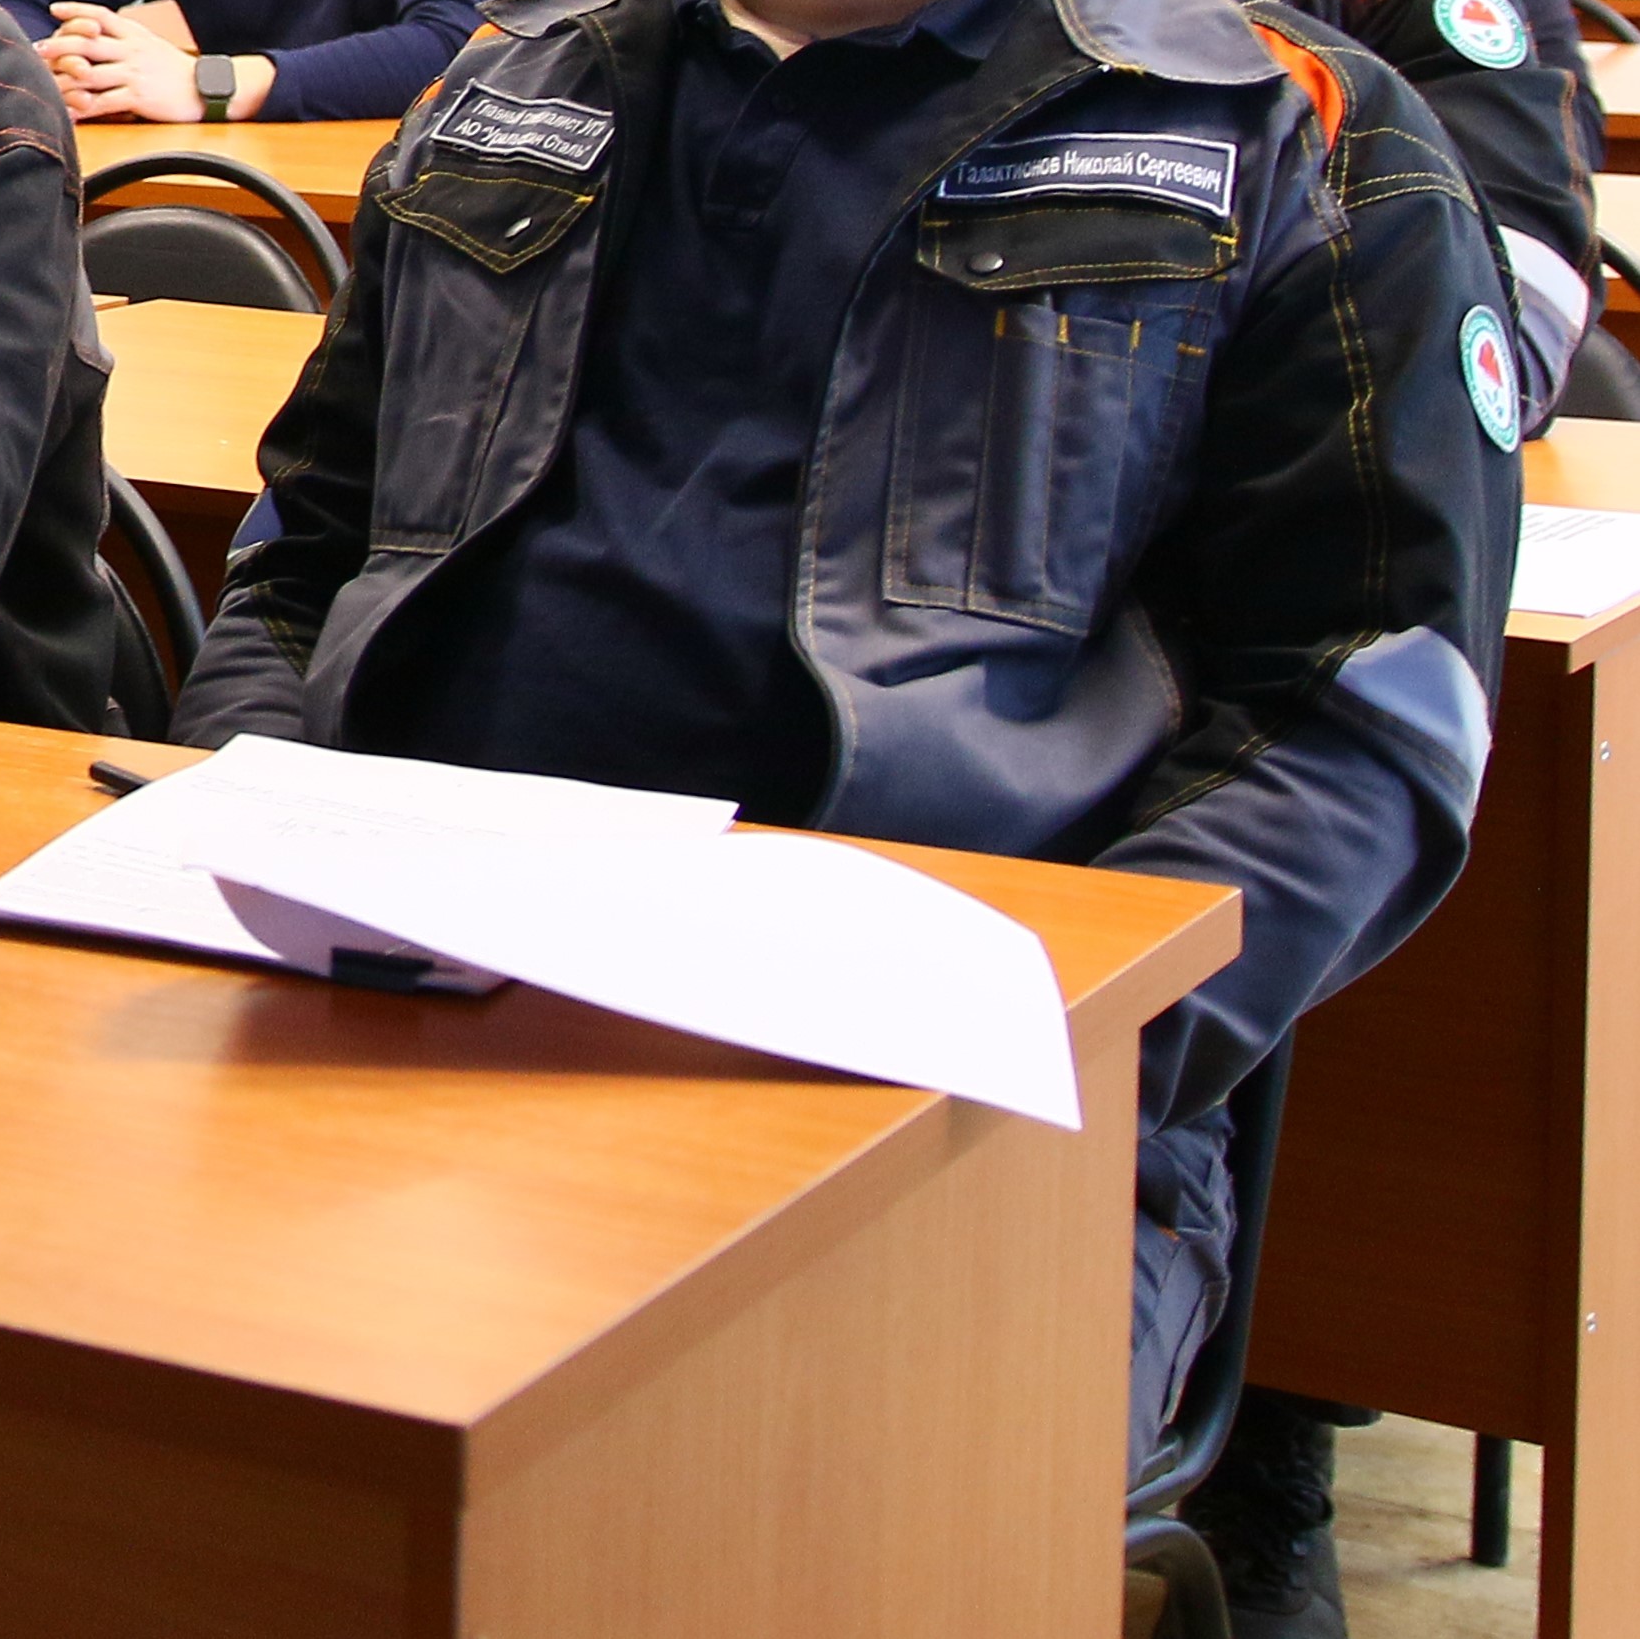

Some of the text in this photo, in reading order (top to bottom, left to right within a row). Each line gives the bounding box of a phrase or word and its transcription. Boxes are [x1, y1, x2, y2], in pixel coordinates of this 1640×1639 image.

[454, 118, 482, 136] АО
[957, 150, 1222, 194] Галактионов Николай Сергеевич
